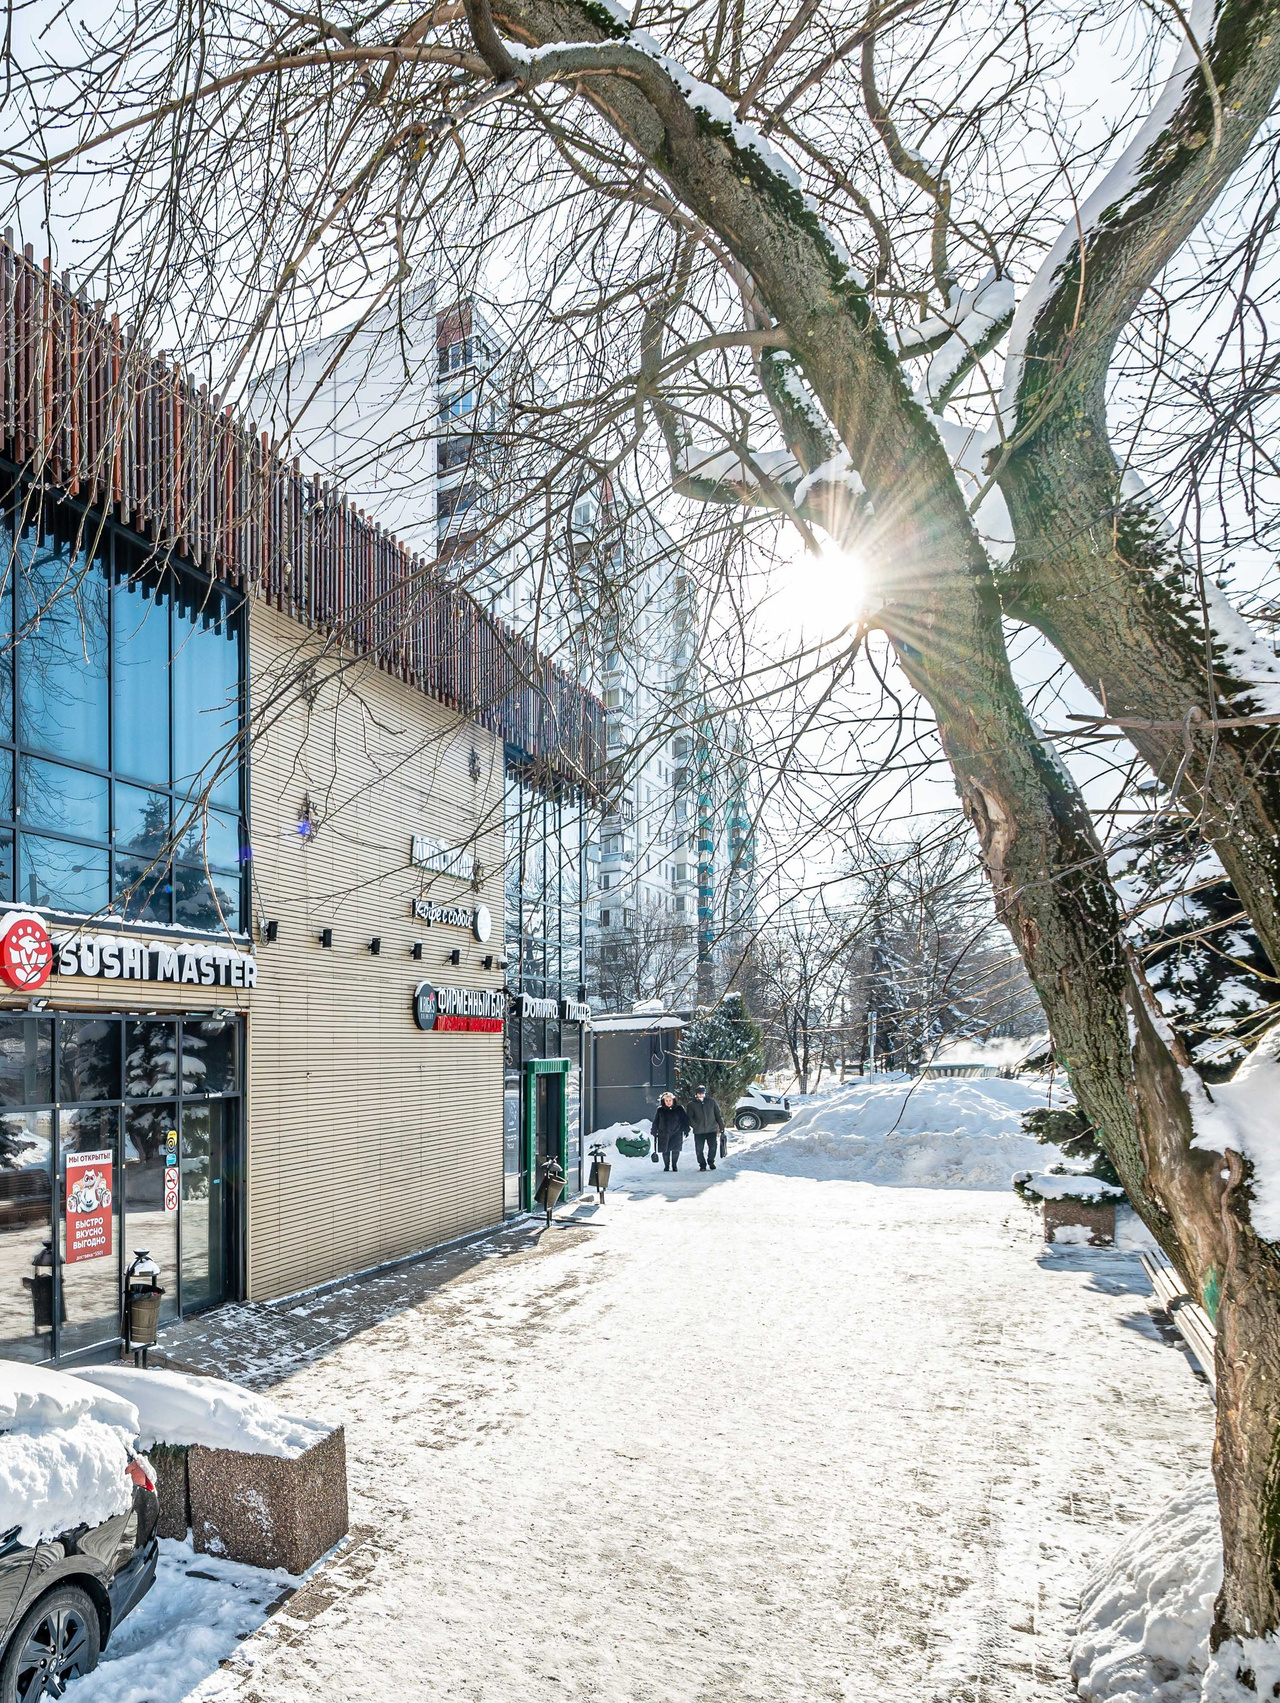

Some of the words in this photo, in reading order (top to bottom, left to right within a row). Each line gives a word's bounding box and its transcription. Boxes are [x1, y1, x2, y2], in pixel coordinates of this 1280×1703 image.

[414, 899, 441, 927] Кофе
[442, 911, 448, 922] с
[448, 908, 472, 928] собой
[59, 941, 149, 980] SUSHI
[157, 950, 258, 988] MASTER
[438, 988, 490, 1017] ФИРМЕННЫЙ
[491, 992, 505, 1018] БАР
[68, 1156, 79, 1164] МЫ
[75, 1217, 104, 1229] БЫСТРО
[76, 1227, 103, 1239] ВКУСНО
[73, 1236, 106, 1250] ВЫГОДНО
